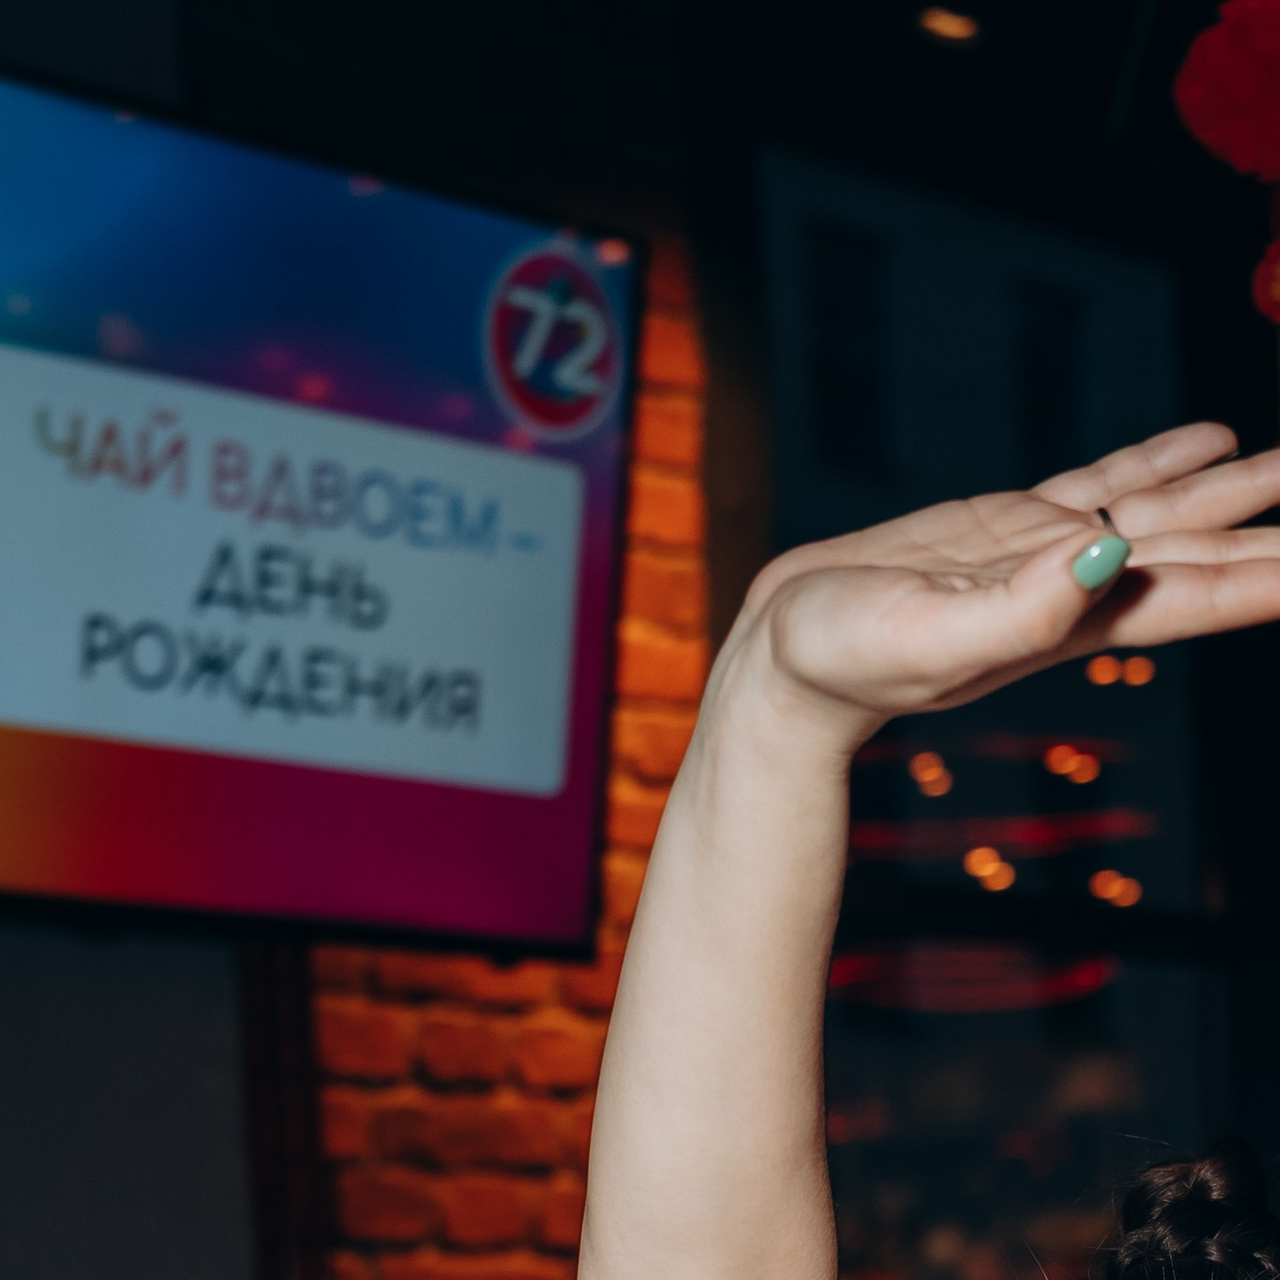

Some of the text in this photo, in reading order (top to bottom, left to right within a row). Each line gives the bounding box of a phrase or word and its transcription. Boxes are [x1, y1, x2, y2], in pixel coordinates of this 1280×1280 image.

[508, 284, 607, 397] 72
[32, 402, 191, 497] ЧАЙ
[194, 540, 390, 631] ДЕНЬ
[79, 611, 484, 734] РОЖДЕНИЯ
